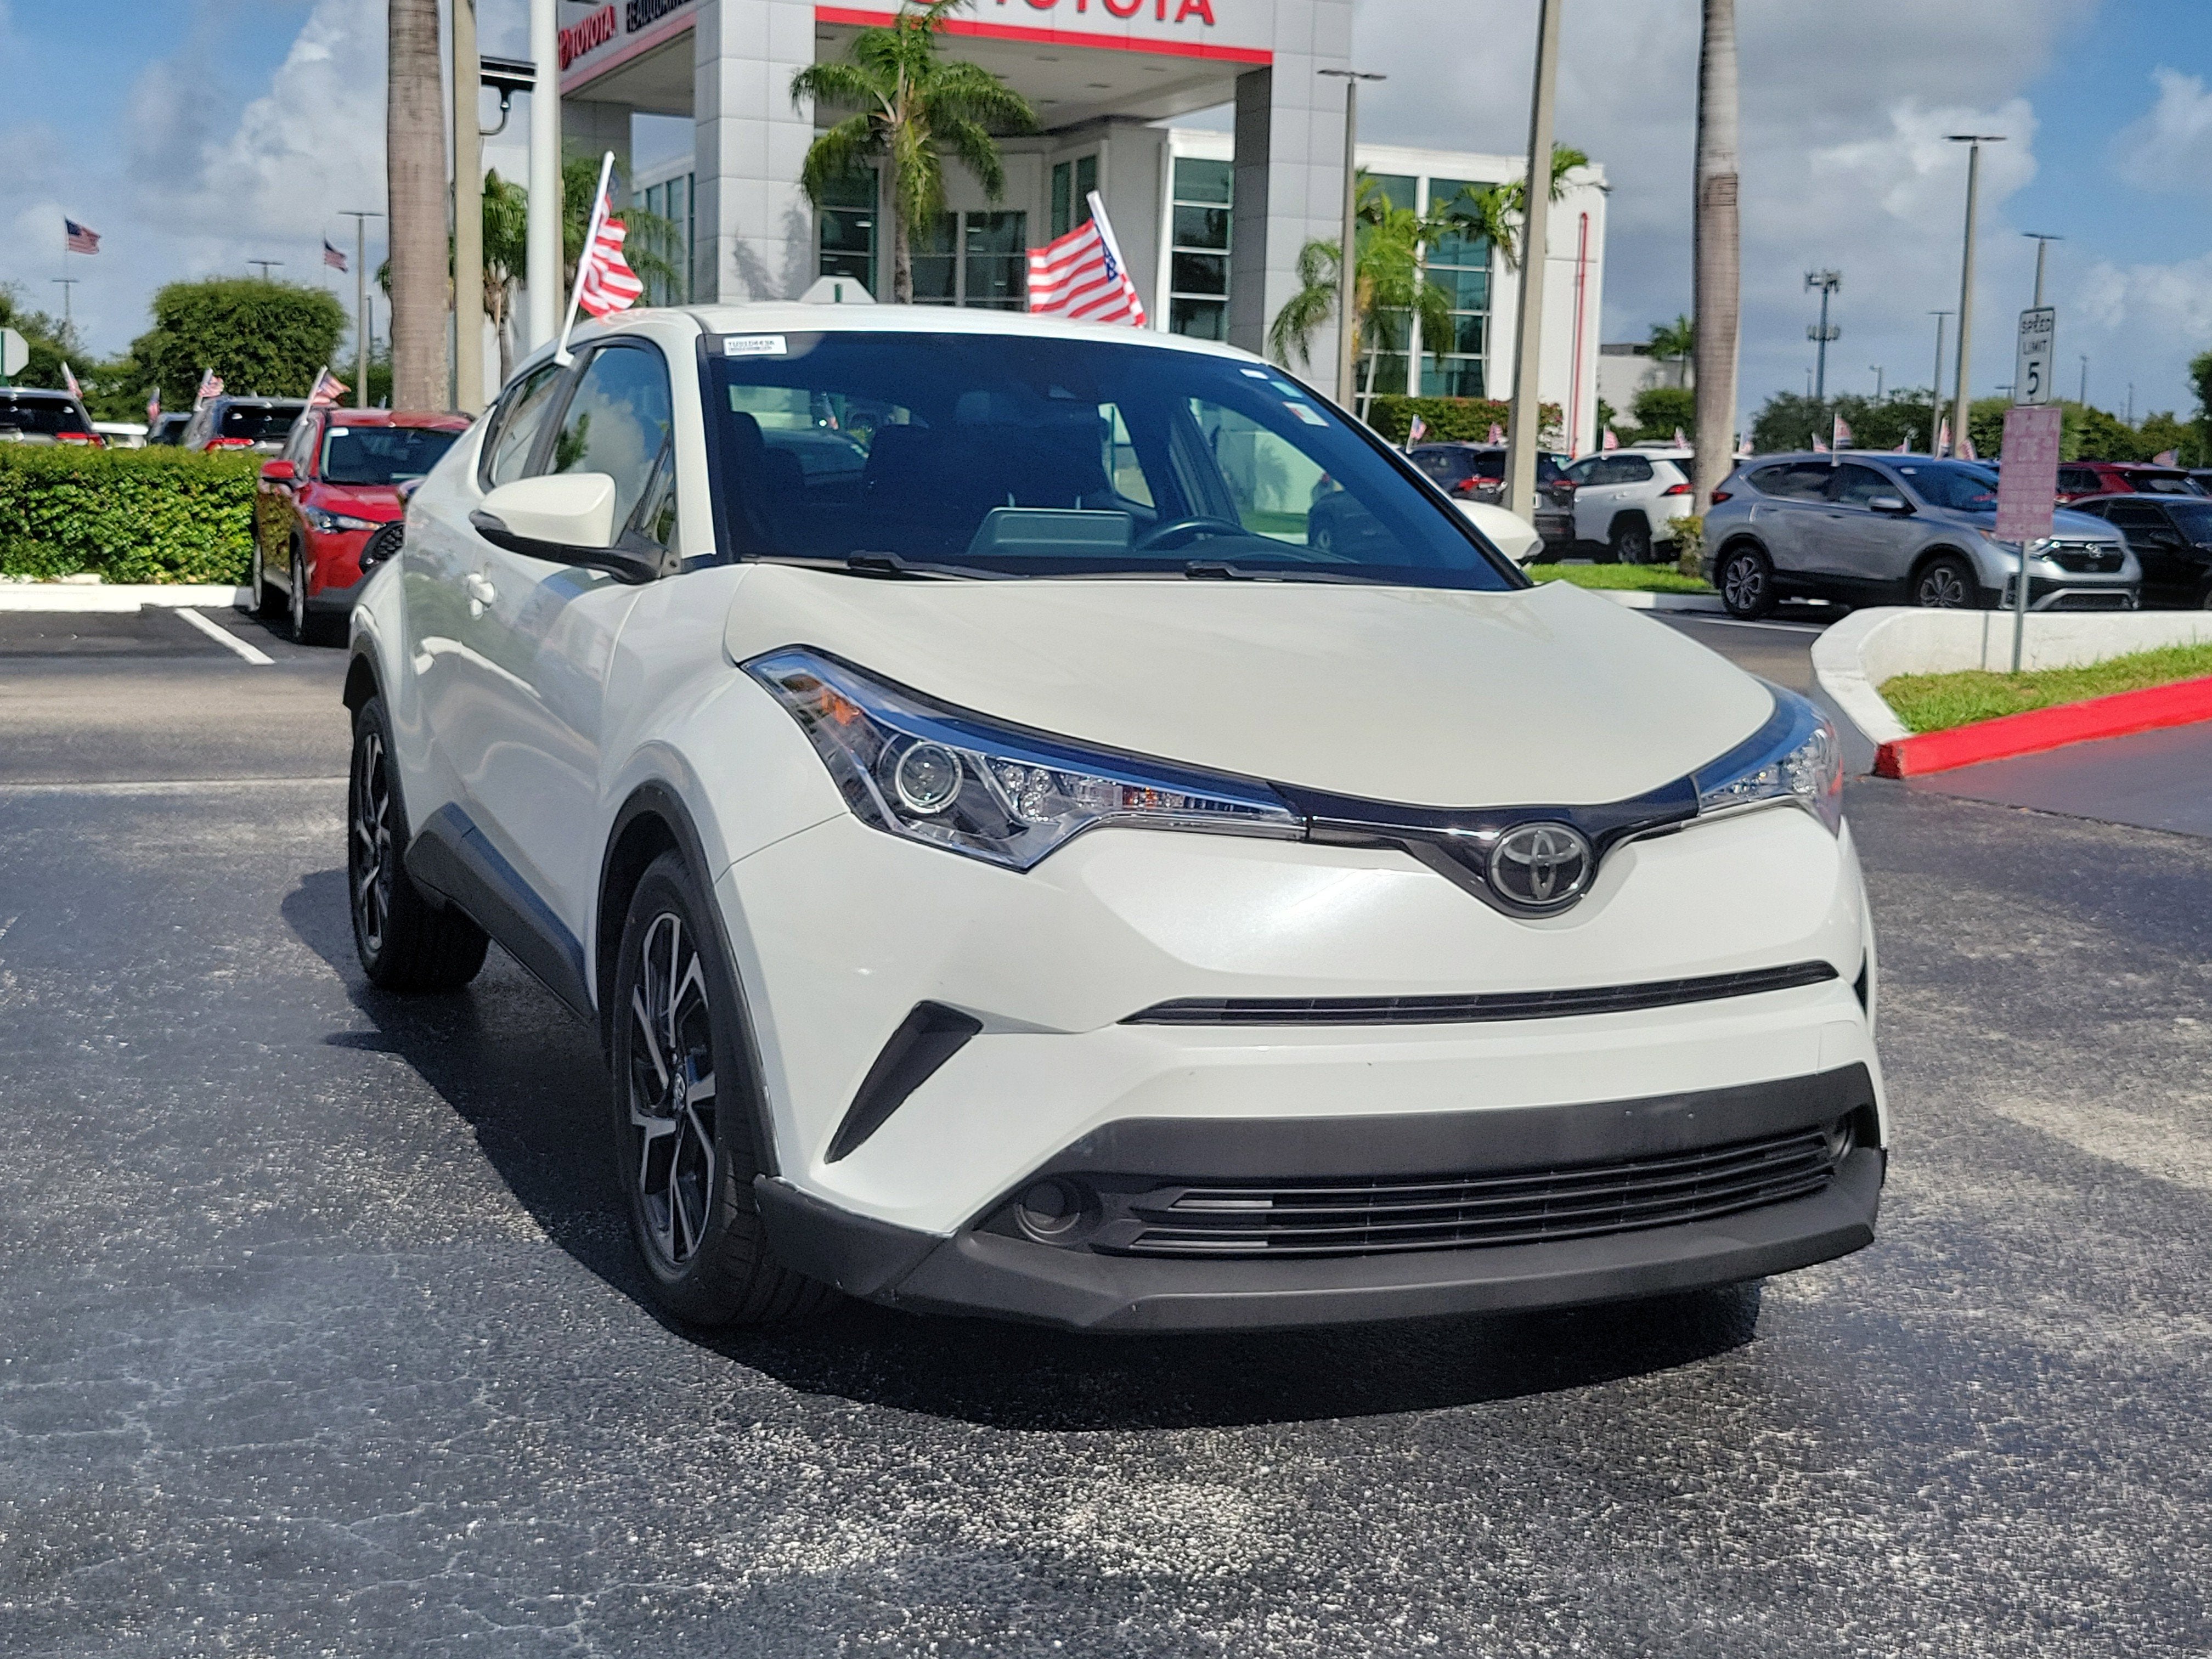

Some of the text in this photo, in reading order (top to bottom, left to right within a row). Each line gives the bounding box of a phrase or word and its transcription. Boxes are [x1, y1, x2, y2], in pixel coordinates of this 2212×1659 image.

[572, 5, 616, 59] TOYOTA
[2022, 318, 2050, 334] SPEED
[2023, 339, 2047, 354] LIMIT
[2027, 362, 2040, 395] 5
